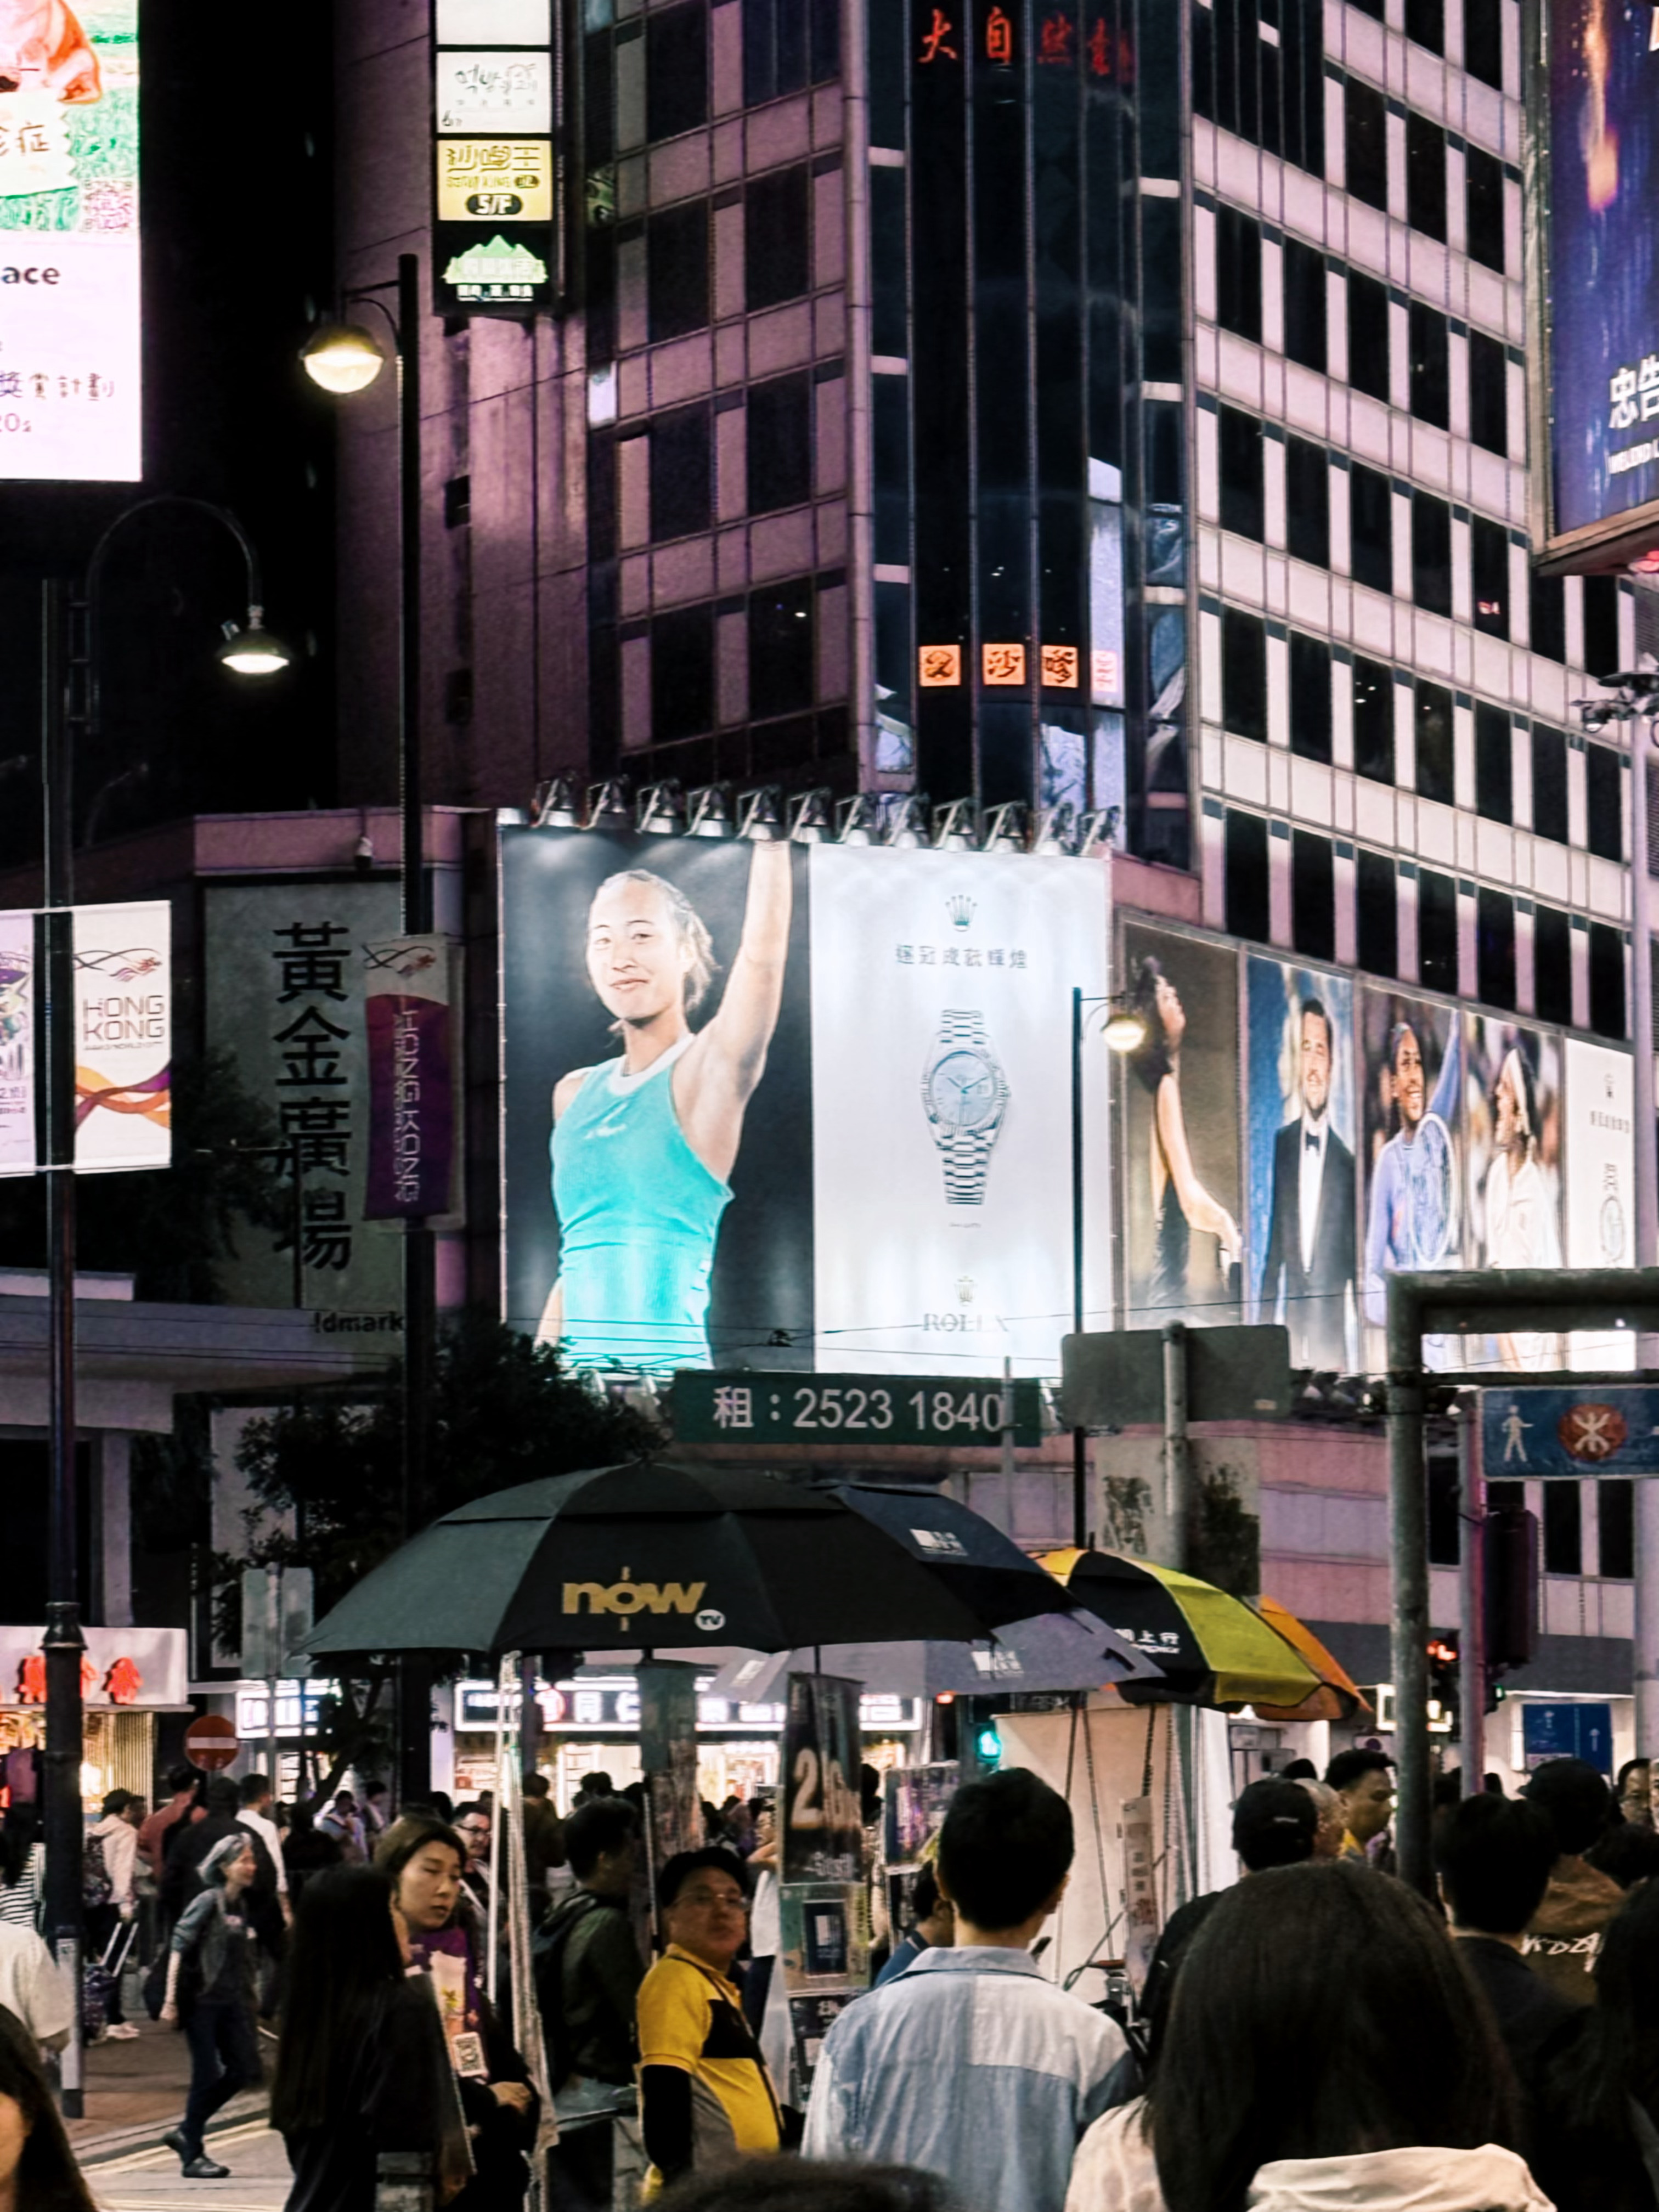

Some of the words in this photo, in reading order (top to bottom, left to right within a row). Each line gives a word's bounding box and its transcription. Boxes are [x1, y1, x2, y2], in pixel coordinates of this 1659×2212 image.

[83, 995, 165, 1018] HONG
[83, 1018, 165, 1041] KONG
[402, 1010, 421, 1103] HONG
[793, 1388, 893, 1429] 2523
[909, 1391, 1003, 1431] 1840
[562, 1575, 707, 1624] now
